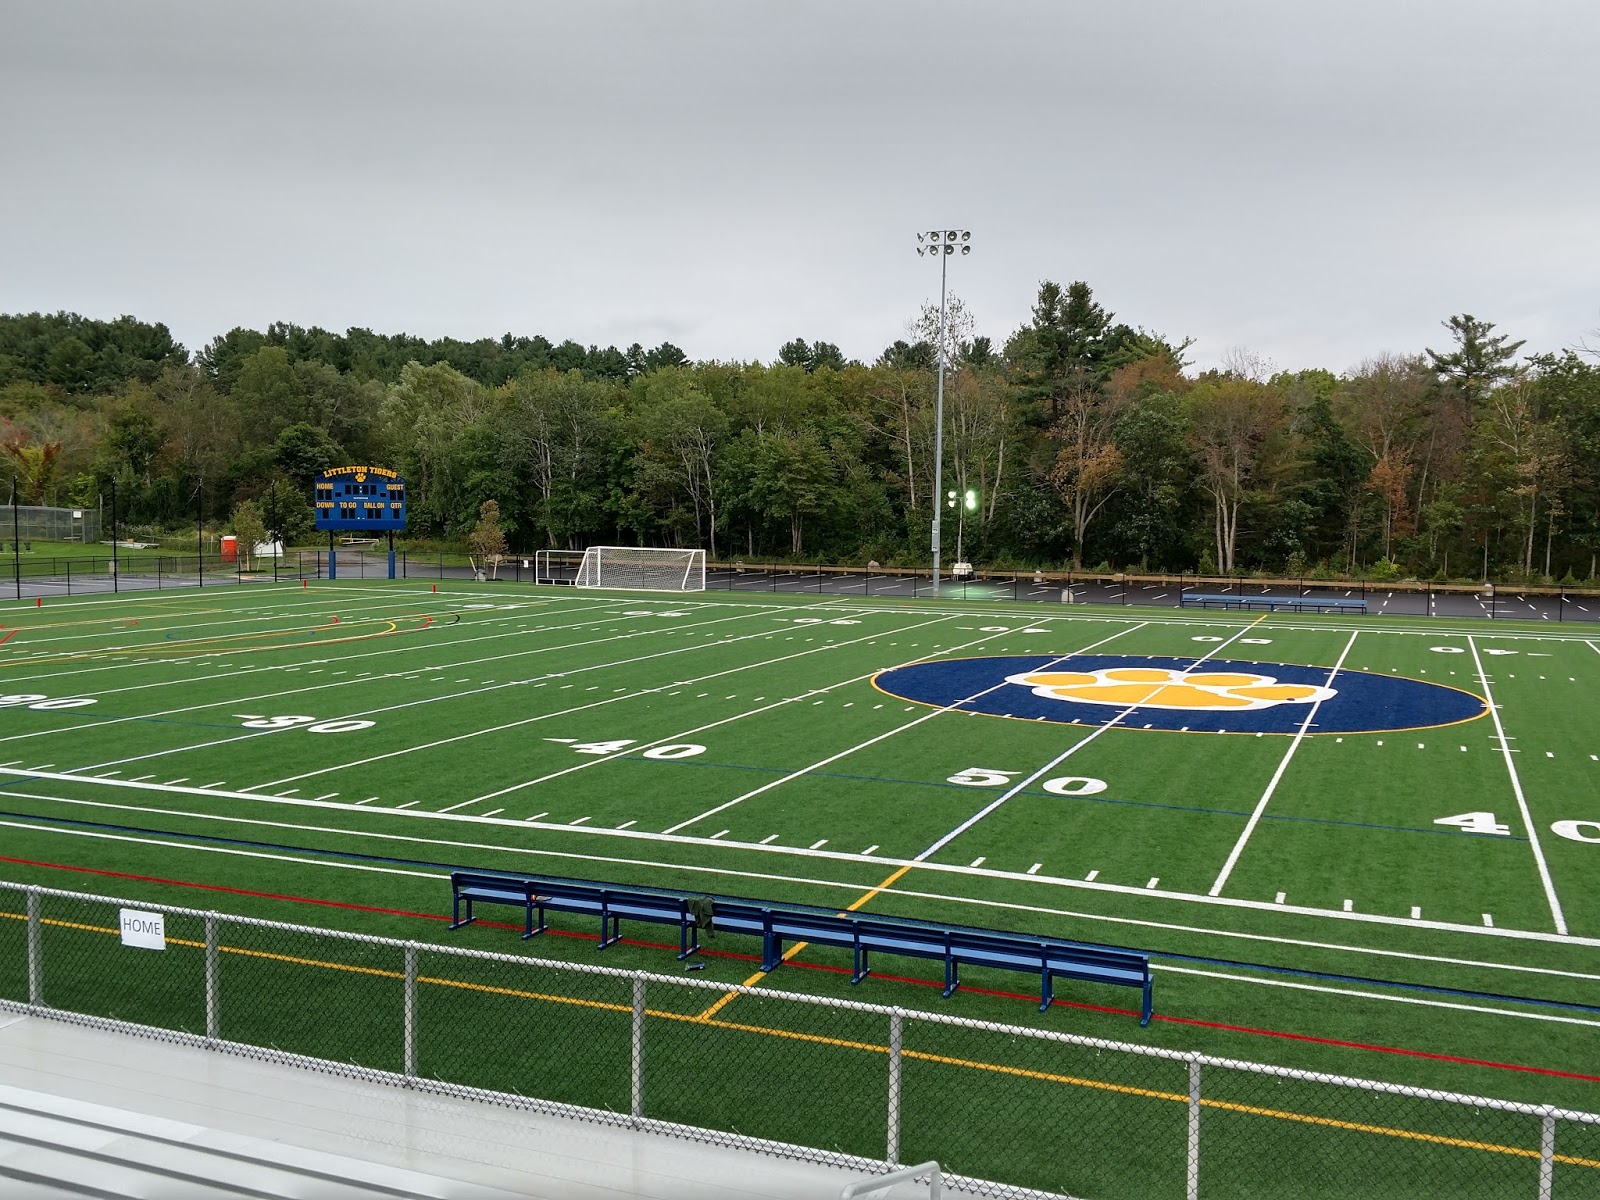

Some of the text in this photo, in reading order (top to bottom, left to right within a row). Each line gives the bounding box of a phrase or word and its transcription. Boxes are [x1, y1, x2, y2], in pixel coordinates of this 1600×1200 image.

[323, 466, 397, 478] LITTLETON TIGERS
[123, 918, 161, 936] HOME
